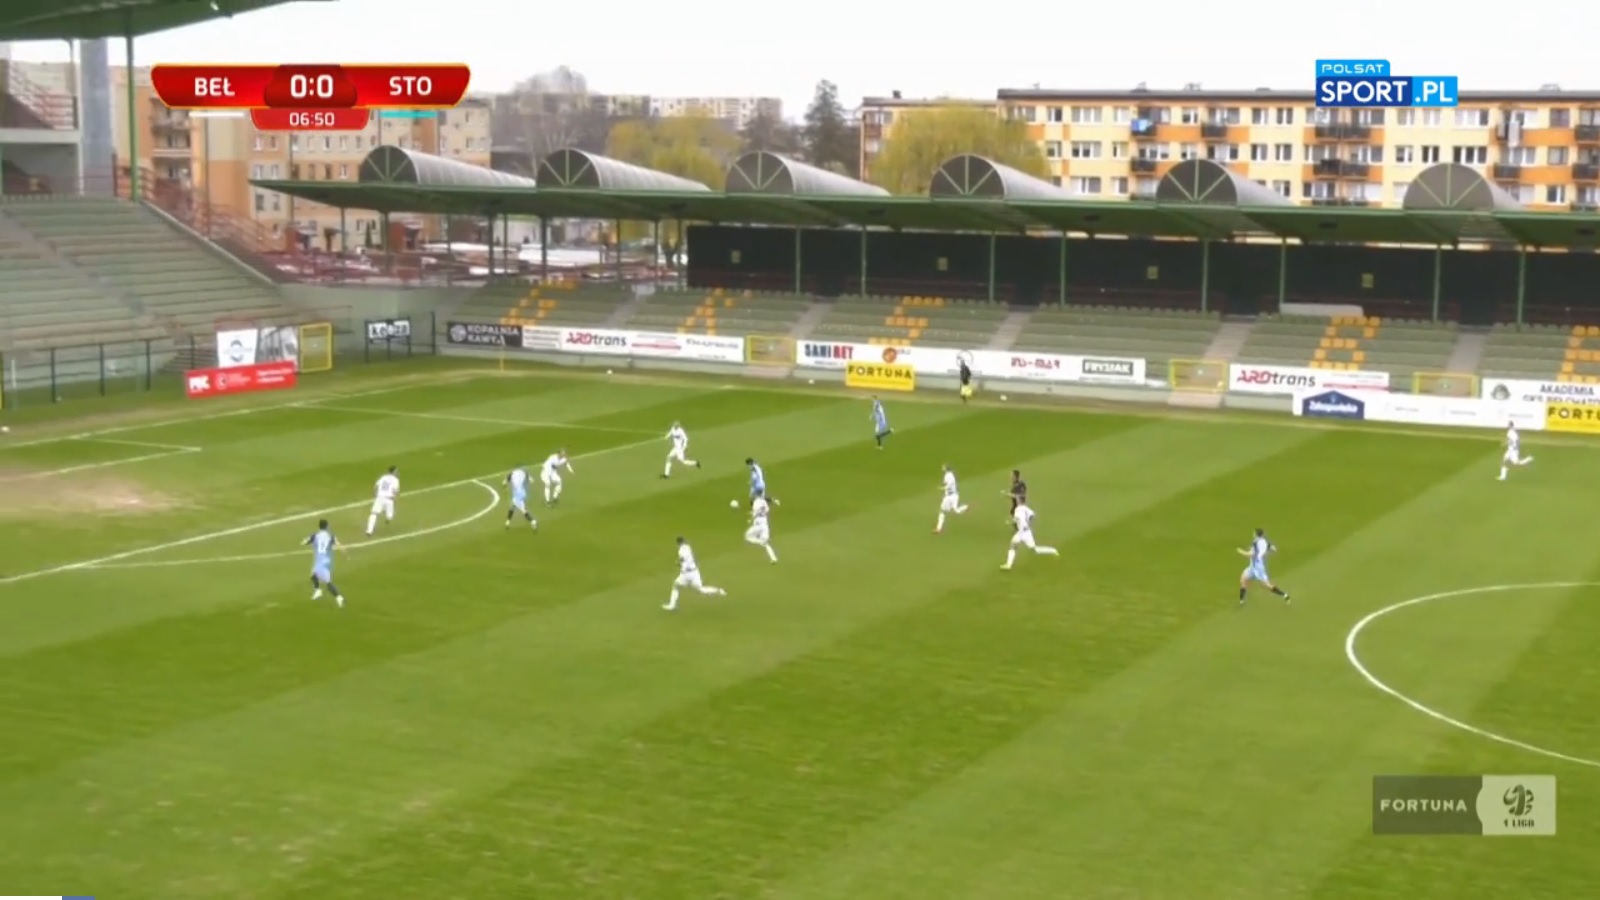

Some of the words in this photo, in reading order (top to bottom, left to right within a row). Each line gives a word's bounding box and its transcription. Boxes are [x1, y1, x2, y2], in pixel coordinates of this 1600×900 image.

[467, 324, 520, 336] KOPALNIA
[847, 364, 912, 380] FORTUNA
[1540, 384, 1595, 396] AKADEMIA
